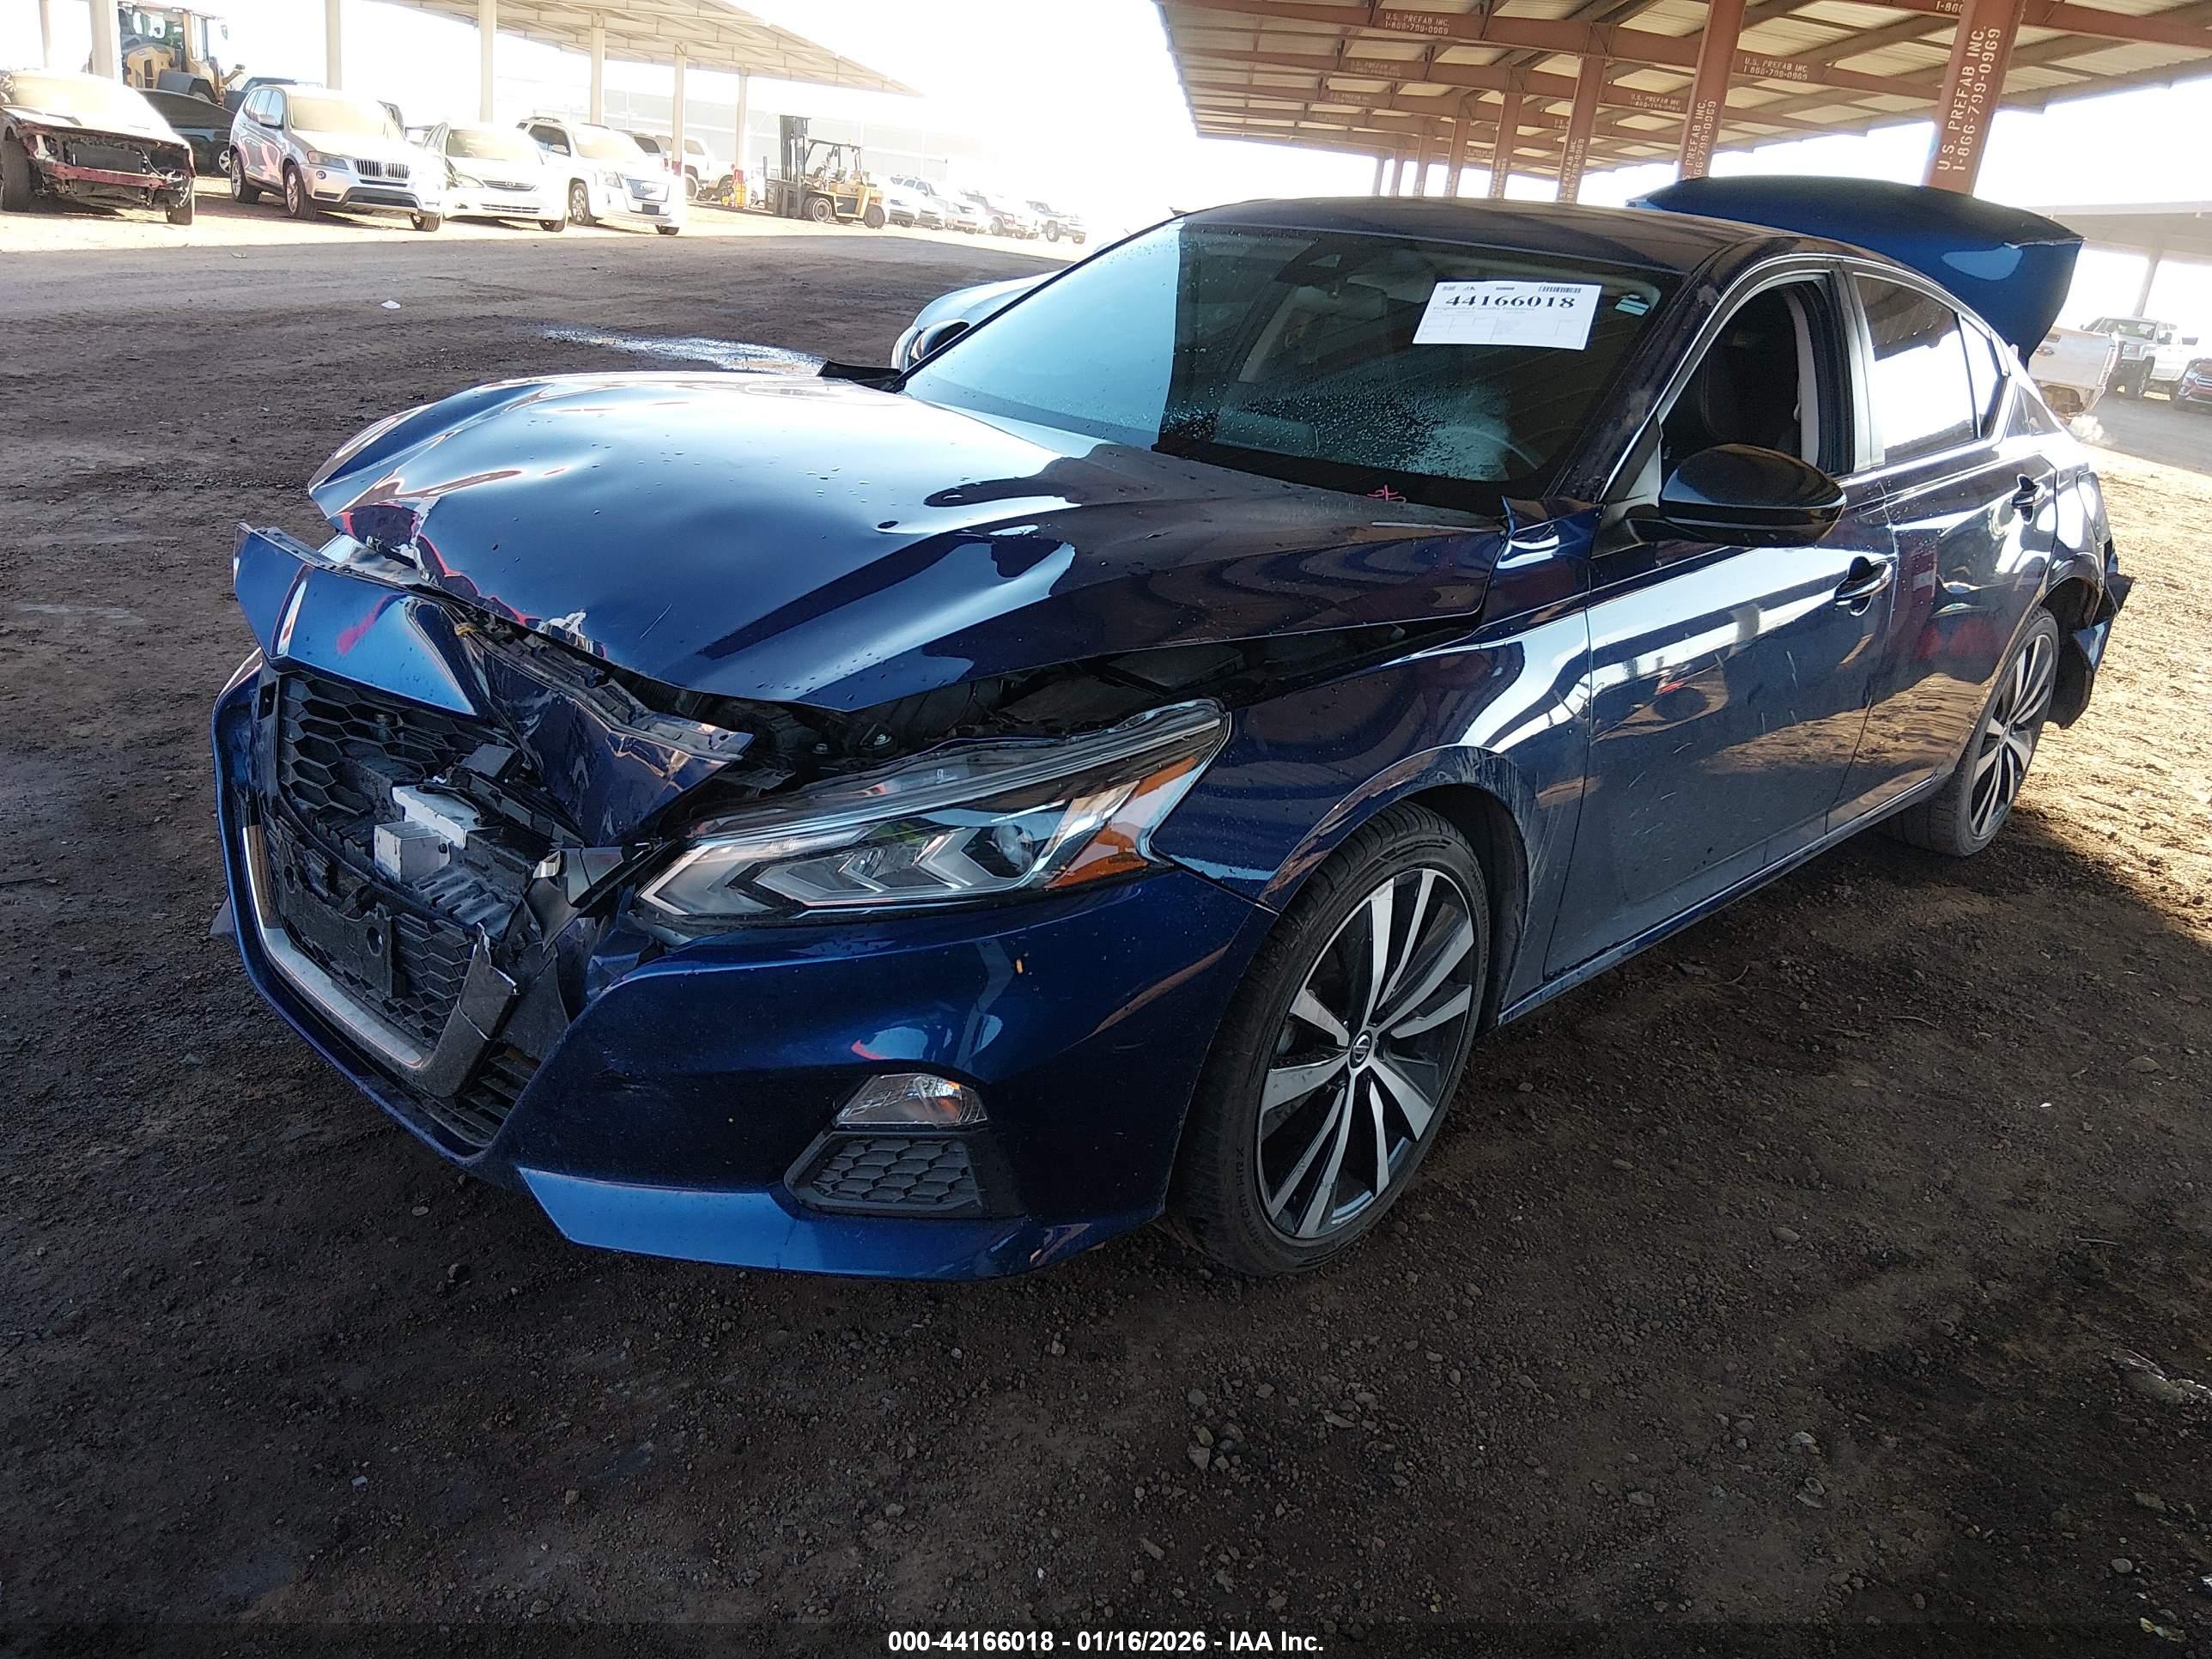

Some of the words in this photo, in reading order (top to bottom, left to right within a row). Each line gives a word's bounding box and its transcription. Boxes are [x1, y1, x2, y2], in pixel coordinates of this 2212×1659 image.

[1403, 14, 1432, 25] PREFAB
[1685, 125, 1701, 166] PREFAB
[1695, 99, 1708, 119] INC.
[1936, 140, 1957, 171] U.S.
[1948, 65, 1975, 131] PREFAB
[1966, 26, 1987, 58] INC.
[1953, 27, 2001, 172] 1-866-799-0969
[1693, 100, 1717, 175] 66-799-0969
[1445, 295, 1576, 309] 44166018
